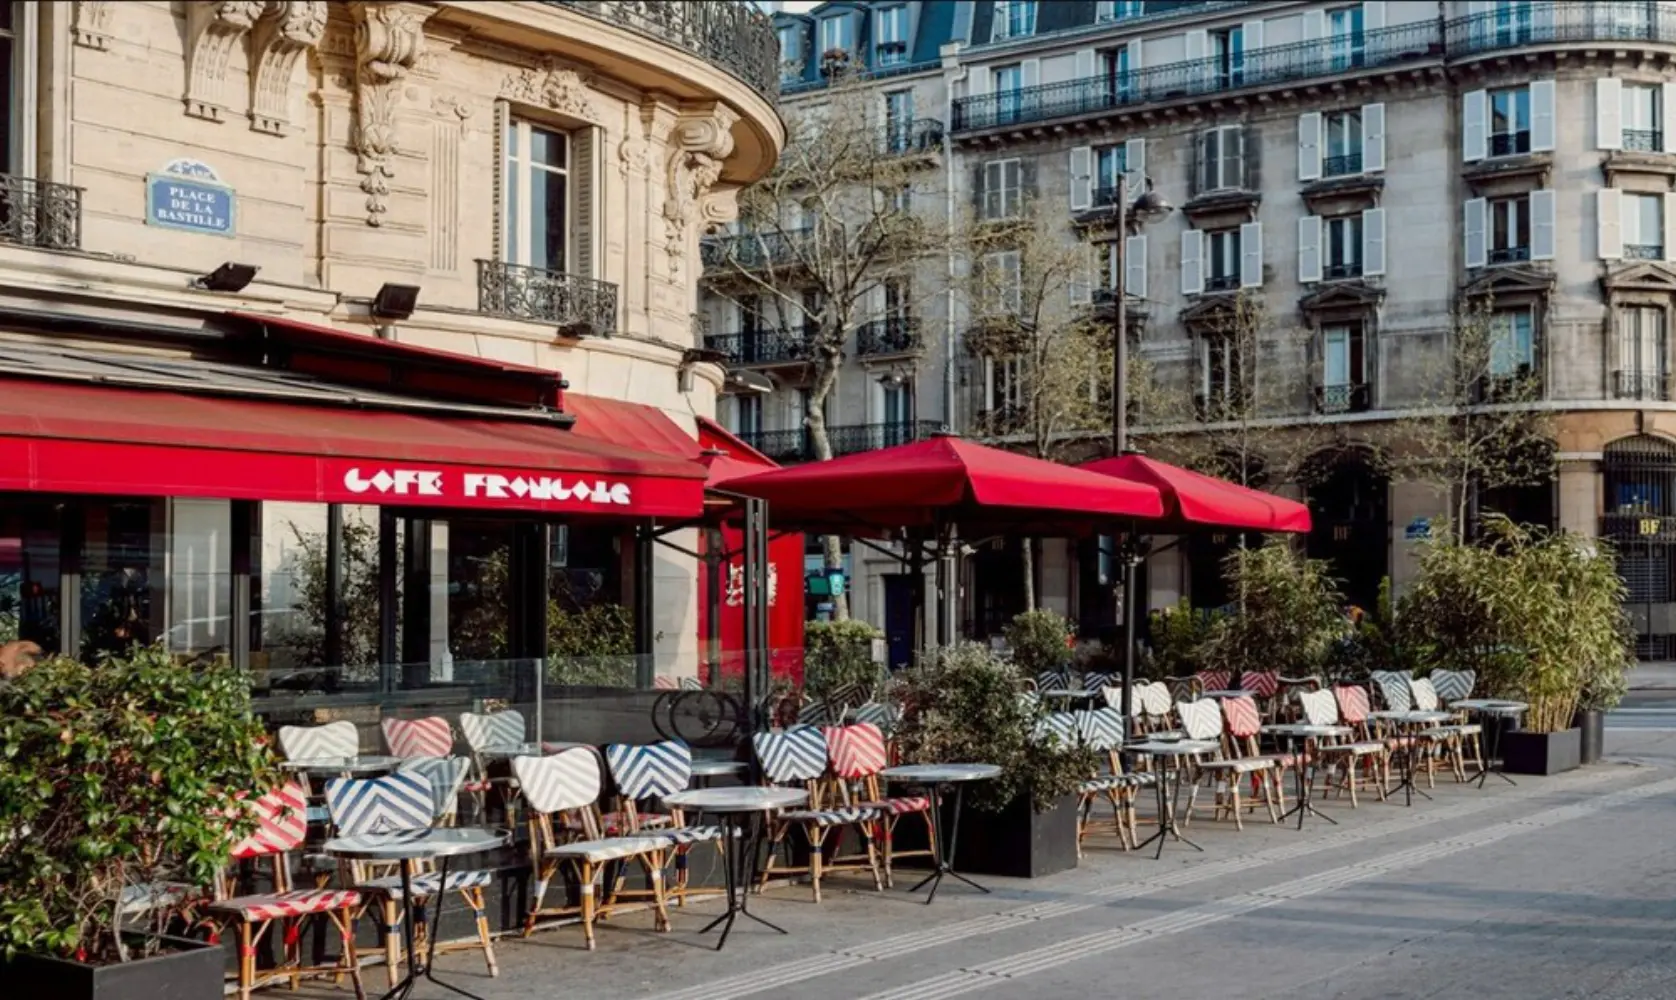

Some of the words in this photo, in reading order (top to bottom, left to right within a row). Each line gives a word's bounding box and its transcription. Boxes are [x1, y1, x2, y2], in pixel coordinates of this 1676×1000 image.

[169, 187, 216, 203] PLACE
[171, 199, 190, 211] DE
[195, 202, 213, 215] LA
[158, 208, 225, 229] BASTILLE
[1640, 519, 1660, 535] BF
